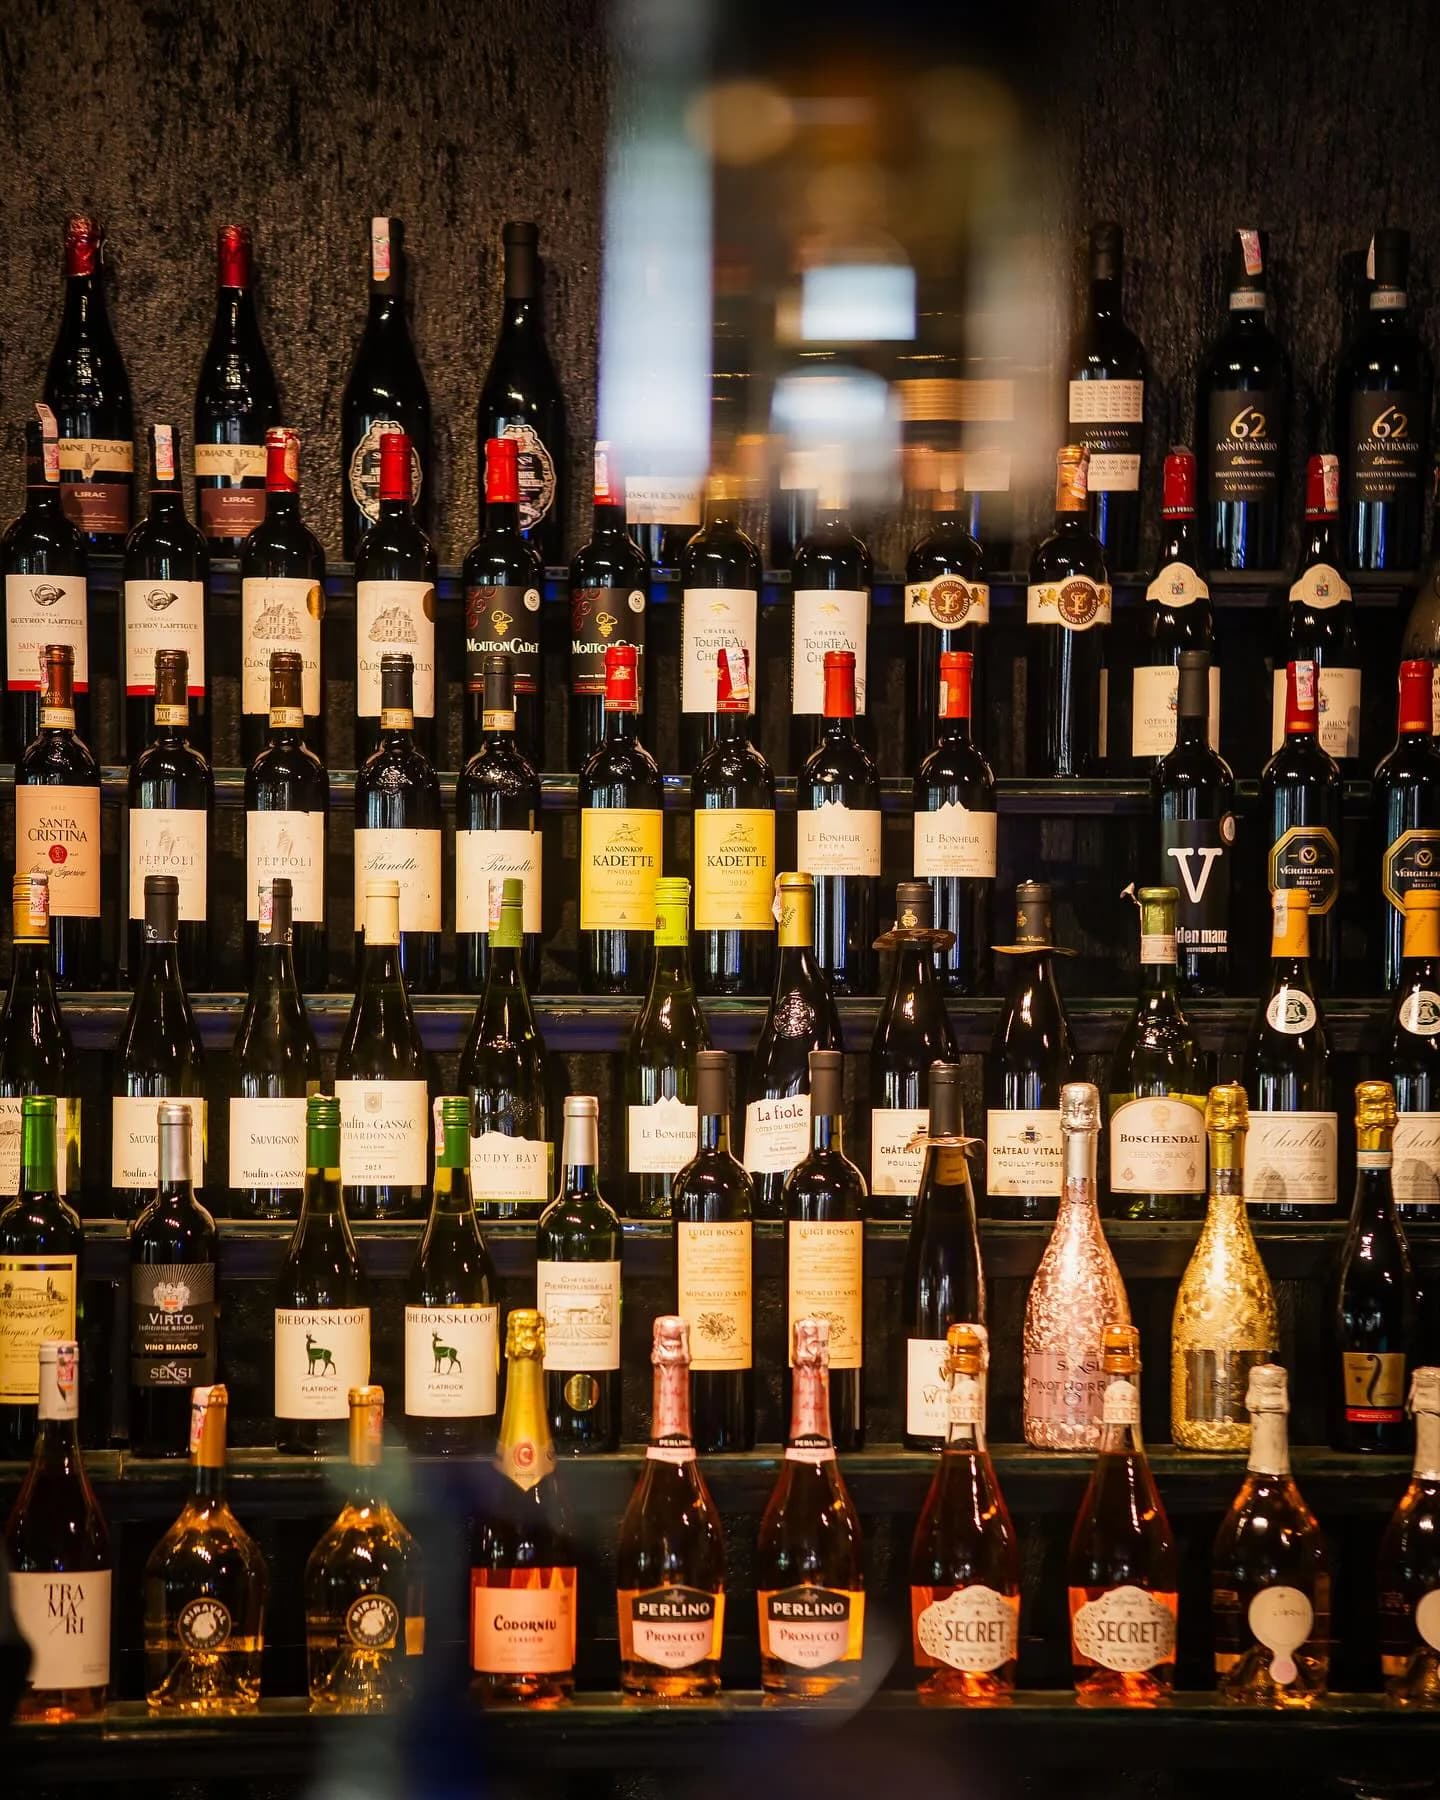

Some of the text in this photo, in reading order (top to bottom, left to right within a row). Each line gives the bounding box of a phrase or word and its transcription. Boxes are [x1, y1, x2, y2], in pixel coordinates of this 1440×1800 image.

[1230, 405, 1266, 438] 62
[1372, 405, 1408, 438] 62
[1216, 442, 1277, 451] ANNIVERSARIO
[1358, 442, 1418, 451] ANNIVERSARIO
[74, 490, 107, 499] LIRAC
[39, 817, 78, 829] SANTA
[28, 828, 88, 842] CRISTINA
[819, 832, 861, 842] BONHEUR
[938, 833, 980, 844] BONHEUR
[593, 855, 654, 867] KADETTE
[707, 855, 767, 867] KADETTE
[1168, 848, 1223, 903] V
[1201, 930, 1227, 943] manz
[757, 1103, 804, 1122] La fiole
[250, 1133, 299, 1145] SAUVIGNON
[343, 1132, 408, 1140] HARDONNAY
[655, 1129, 697, 1139] BONHEUR
[1120, 1134, 1200, 1144] BOSCHENDAL
[880, 1145, 921, 1154] CHÂTEAU
[993, 1146, 1030, 1155] CHÂTEAU
[472, 1154, 539, 1163] OUDY BAY
[716, 1229, 744, 1237] BOSCA
[827, 1229, 855, 1237] BOSCA
[149, 1313, 194, 1324] VIRTO
[278, 1314, 365, 1325] RHEBOKSKLOOF
[150, 1365, 192, 1379] SENSI
[301, 1385, 338, 1393] FLATROCK
[44, 1584, 84, 1600] TRA
[48, 1600, 77, 1617] MA
[184, 1604, 226, 1625] MIRAVAL
[352, 1600, 395, 1622] MIRAVAL
[639, 1603, 710, 1616] PERLINO
[773, 1602, 844, 1616] PERLINO
[65, 1617, 84, 1634] RI
[944, 1620, 1005, 1642] SECRET
[1097, 1620, 1160, 1643] SECRET
[646, 1630, 705, 1642] PROSECCO
[780, 1629, 839, 1642] PROSECCO
